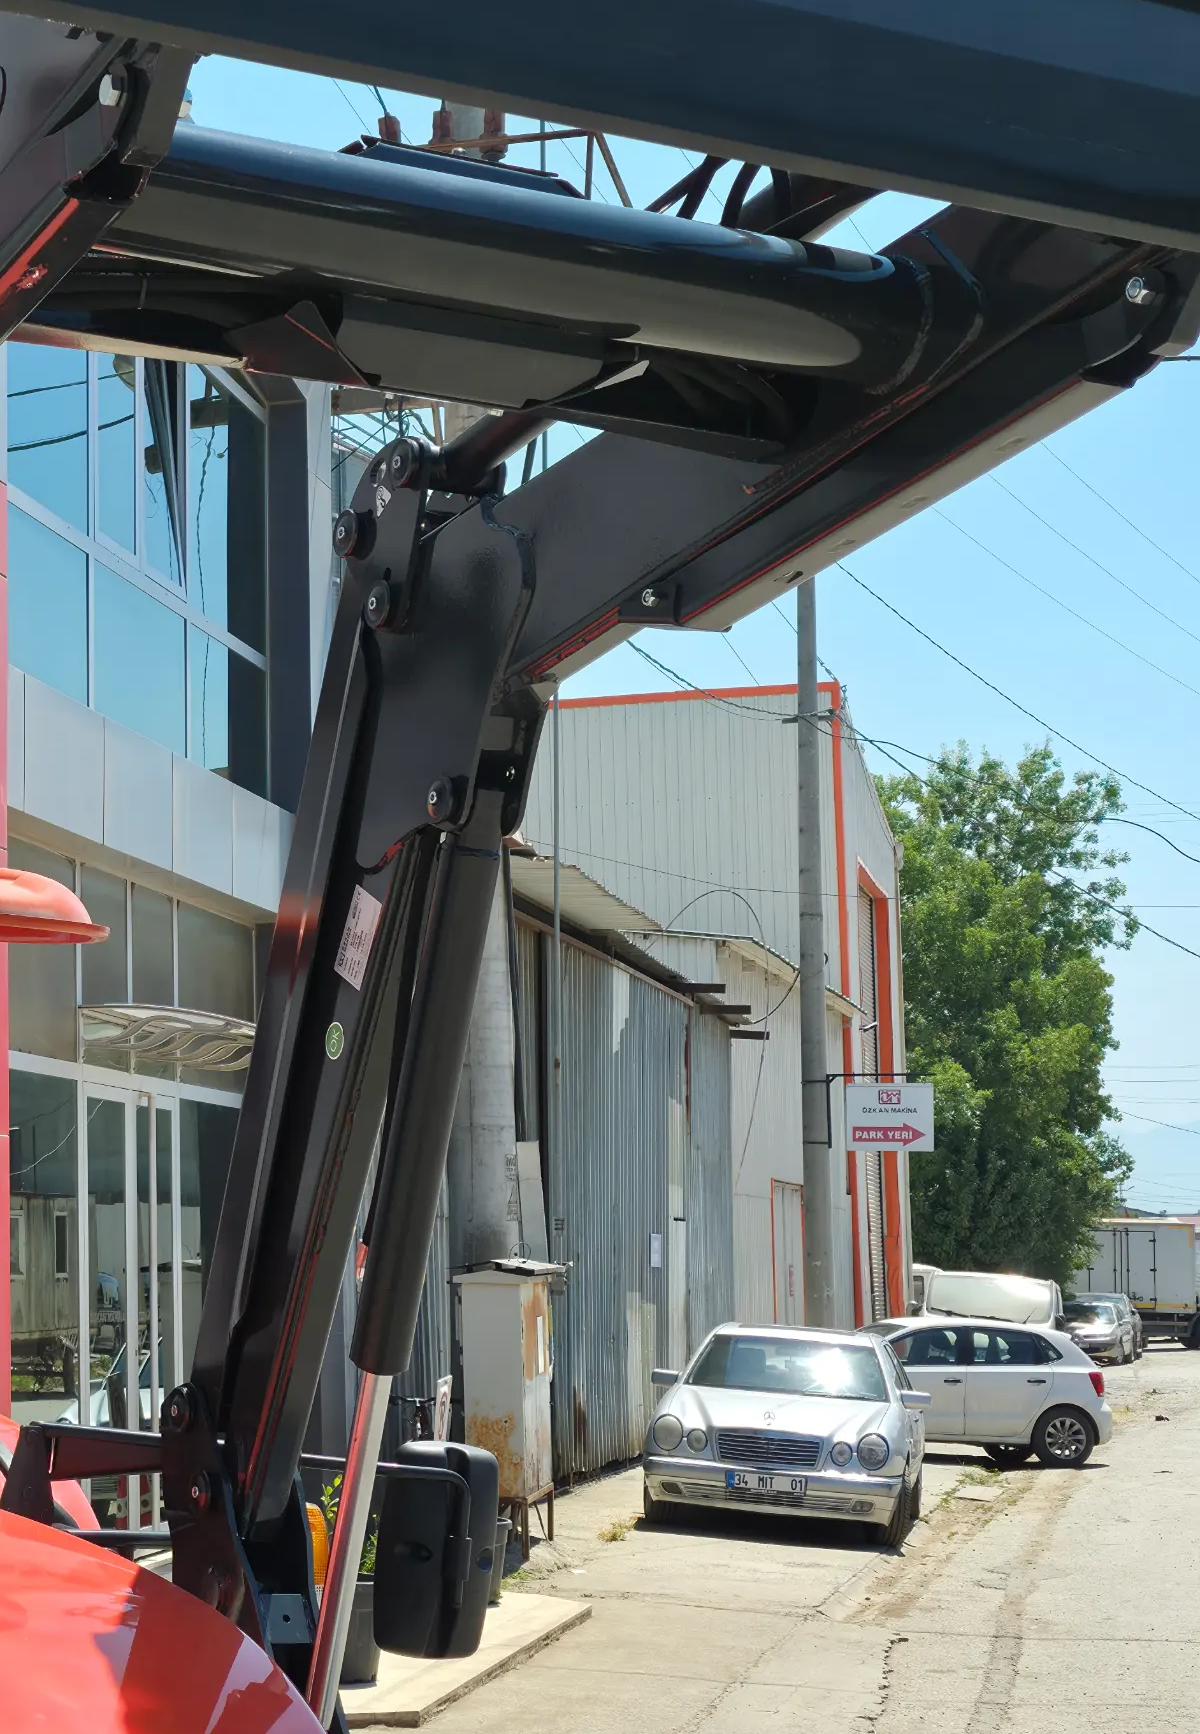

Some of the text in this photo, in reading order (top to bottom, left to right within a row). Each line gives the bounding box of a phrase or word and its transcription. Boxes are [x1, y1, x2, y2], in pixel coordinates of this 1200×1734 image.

[330, 1028, 340, 1052] OK
[890, 1106, 918, 1114] MAKİNA
[855, 1128, 912, 1139] PARK YERİ
[734, 1473, 749, 1486] 34
[757, 1475, 775, 1489] MIT
[790, 1478, 803, 1492] 01
